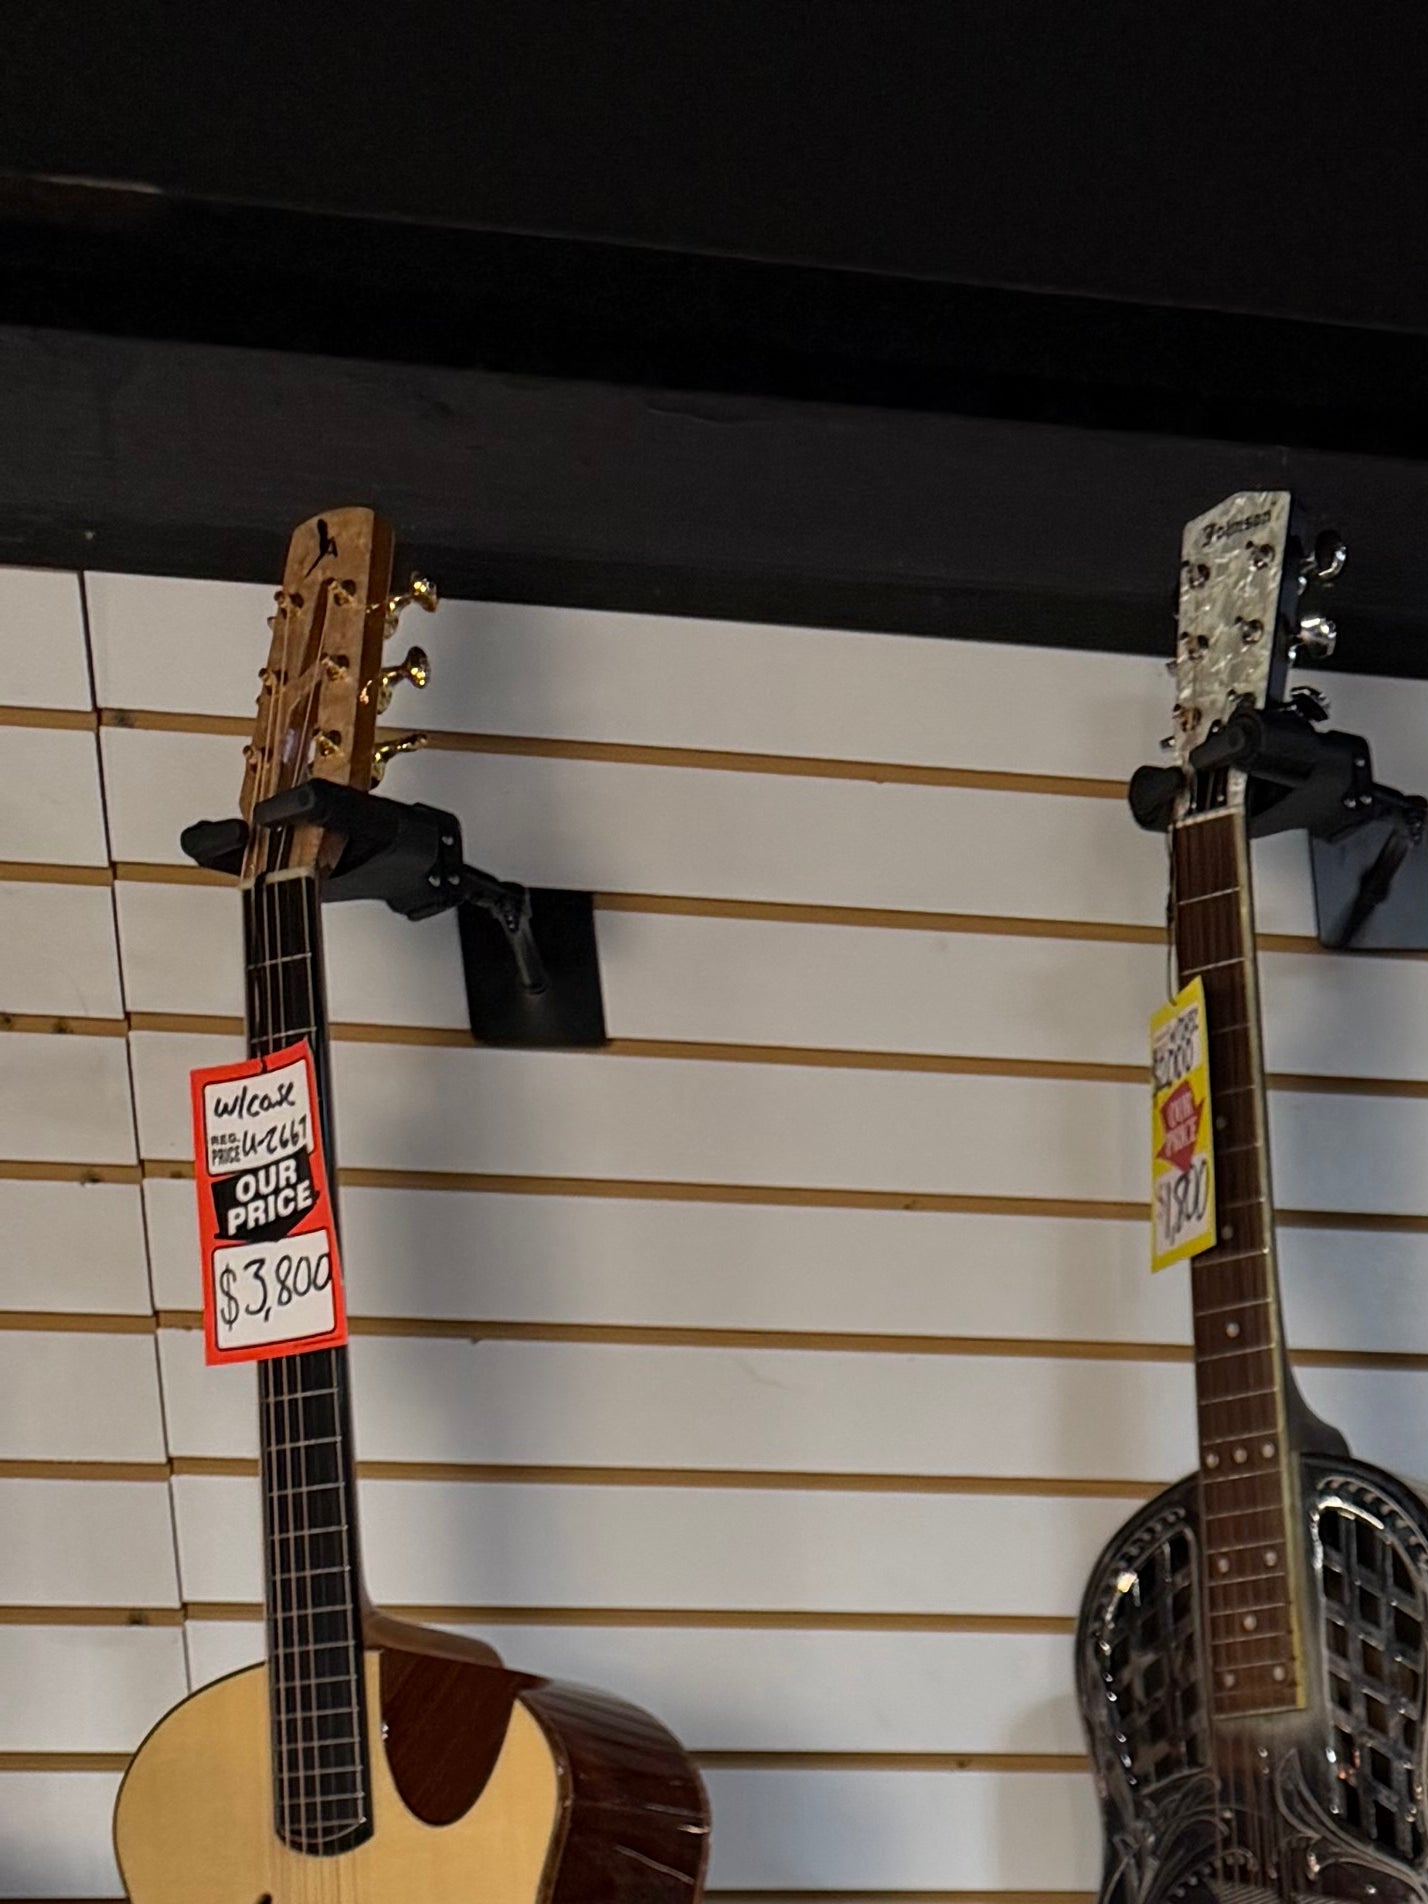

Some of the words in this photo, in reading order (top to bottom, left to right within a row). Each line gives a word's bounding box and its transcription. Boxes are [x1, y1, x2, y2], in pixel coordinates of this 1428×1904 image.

[226, 1179, 313, 1237] PRICE
[235, 1157, 298, 1202] OUR
[219, 1253, 332, 1331] $3,800
